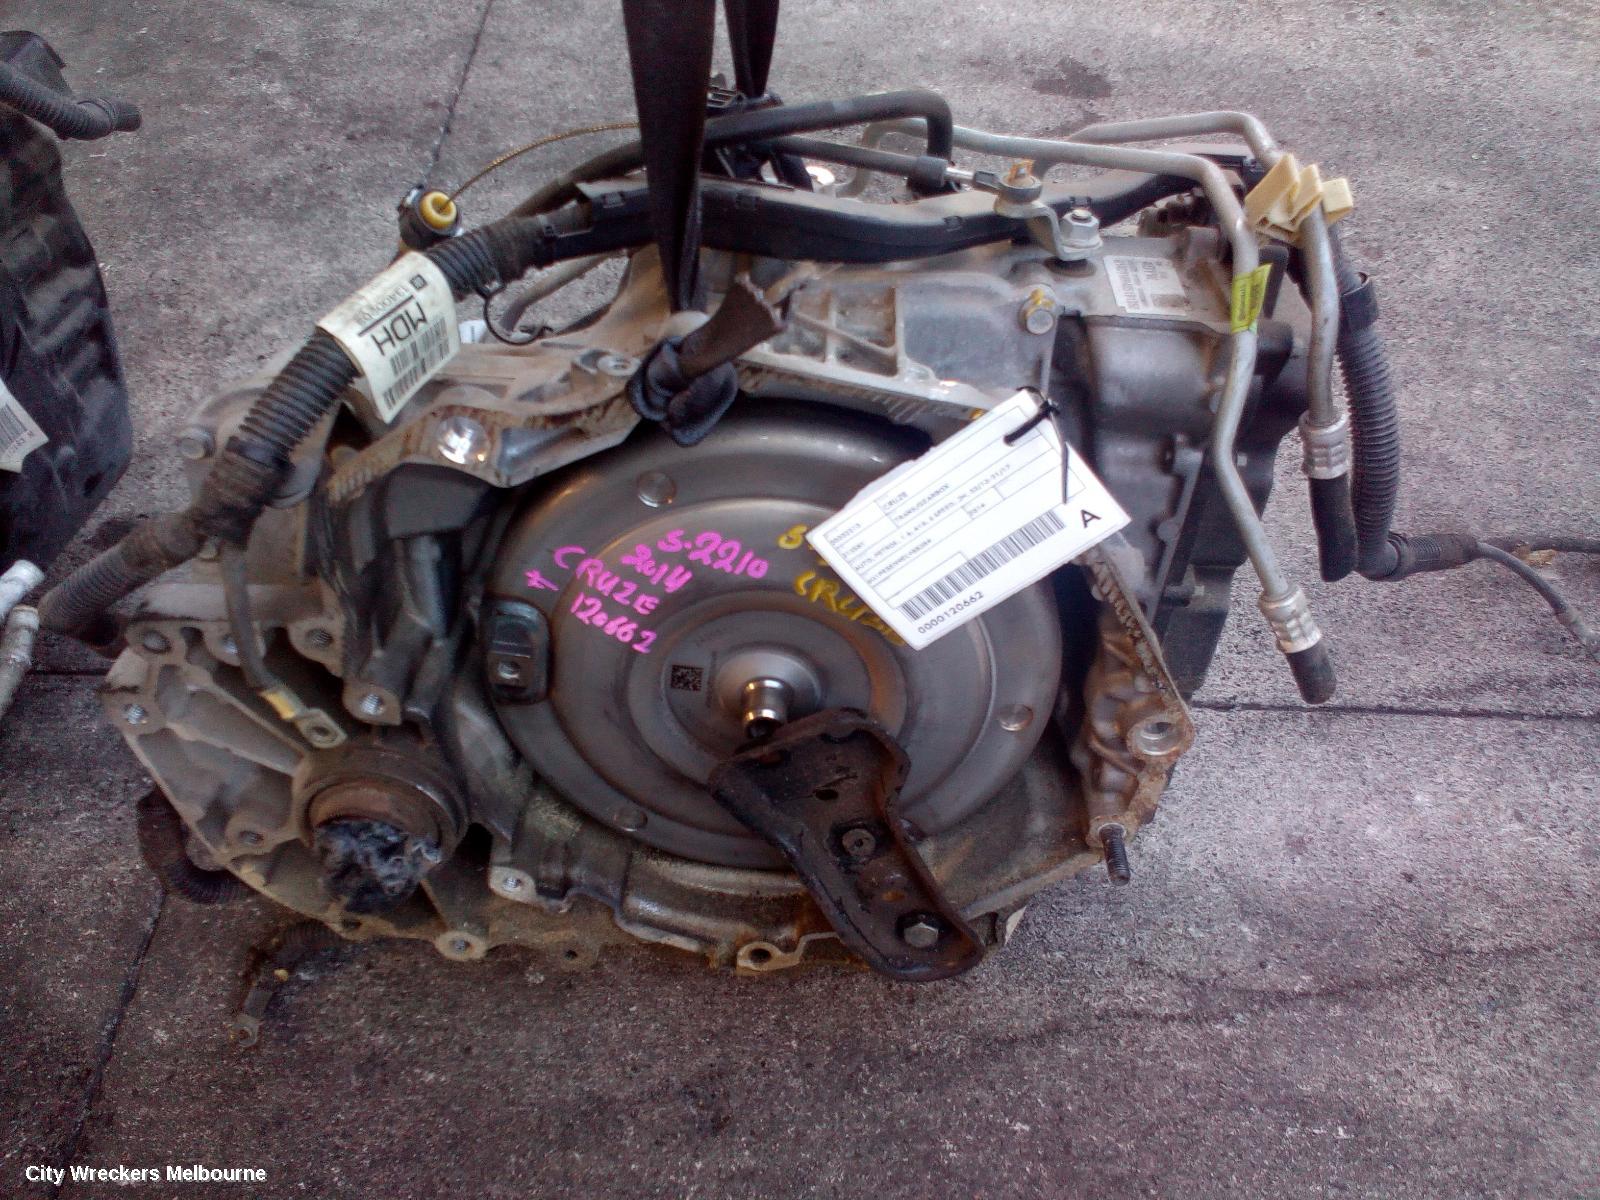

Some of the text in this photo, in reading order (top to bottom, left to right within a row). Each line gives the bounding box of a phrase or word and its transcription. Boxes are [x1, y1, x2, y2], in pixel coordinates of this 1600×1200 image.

[1080, 509, 1102, 529] A
[554, 545, 660, 615] CRUZE
[620, 544, 693, 593] 2014
[570, 591, 657, 654] 120662
[917, 591, 985, 634] 0000120662
